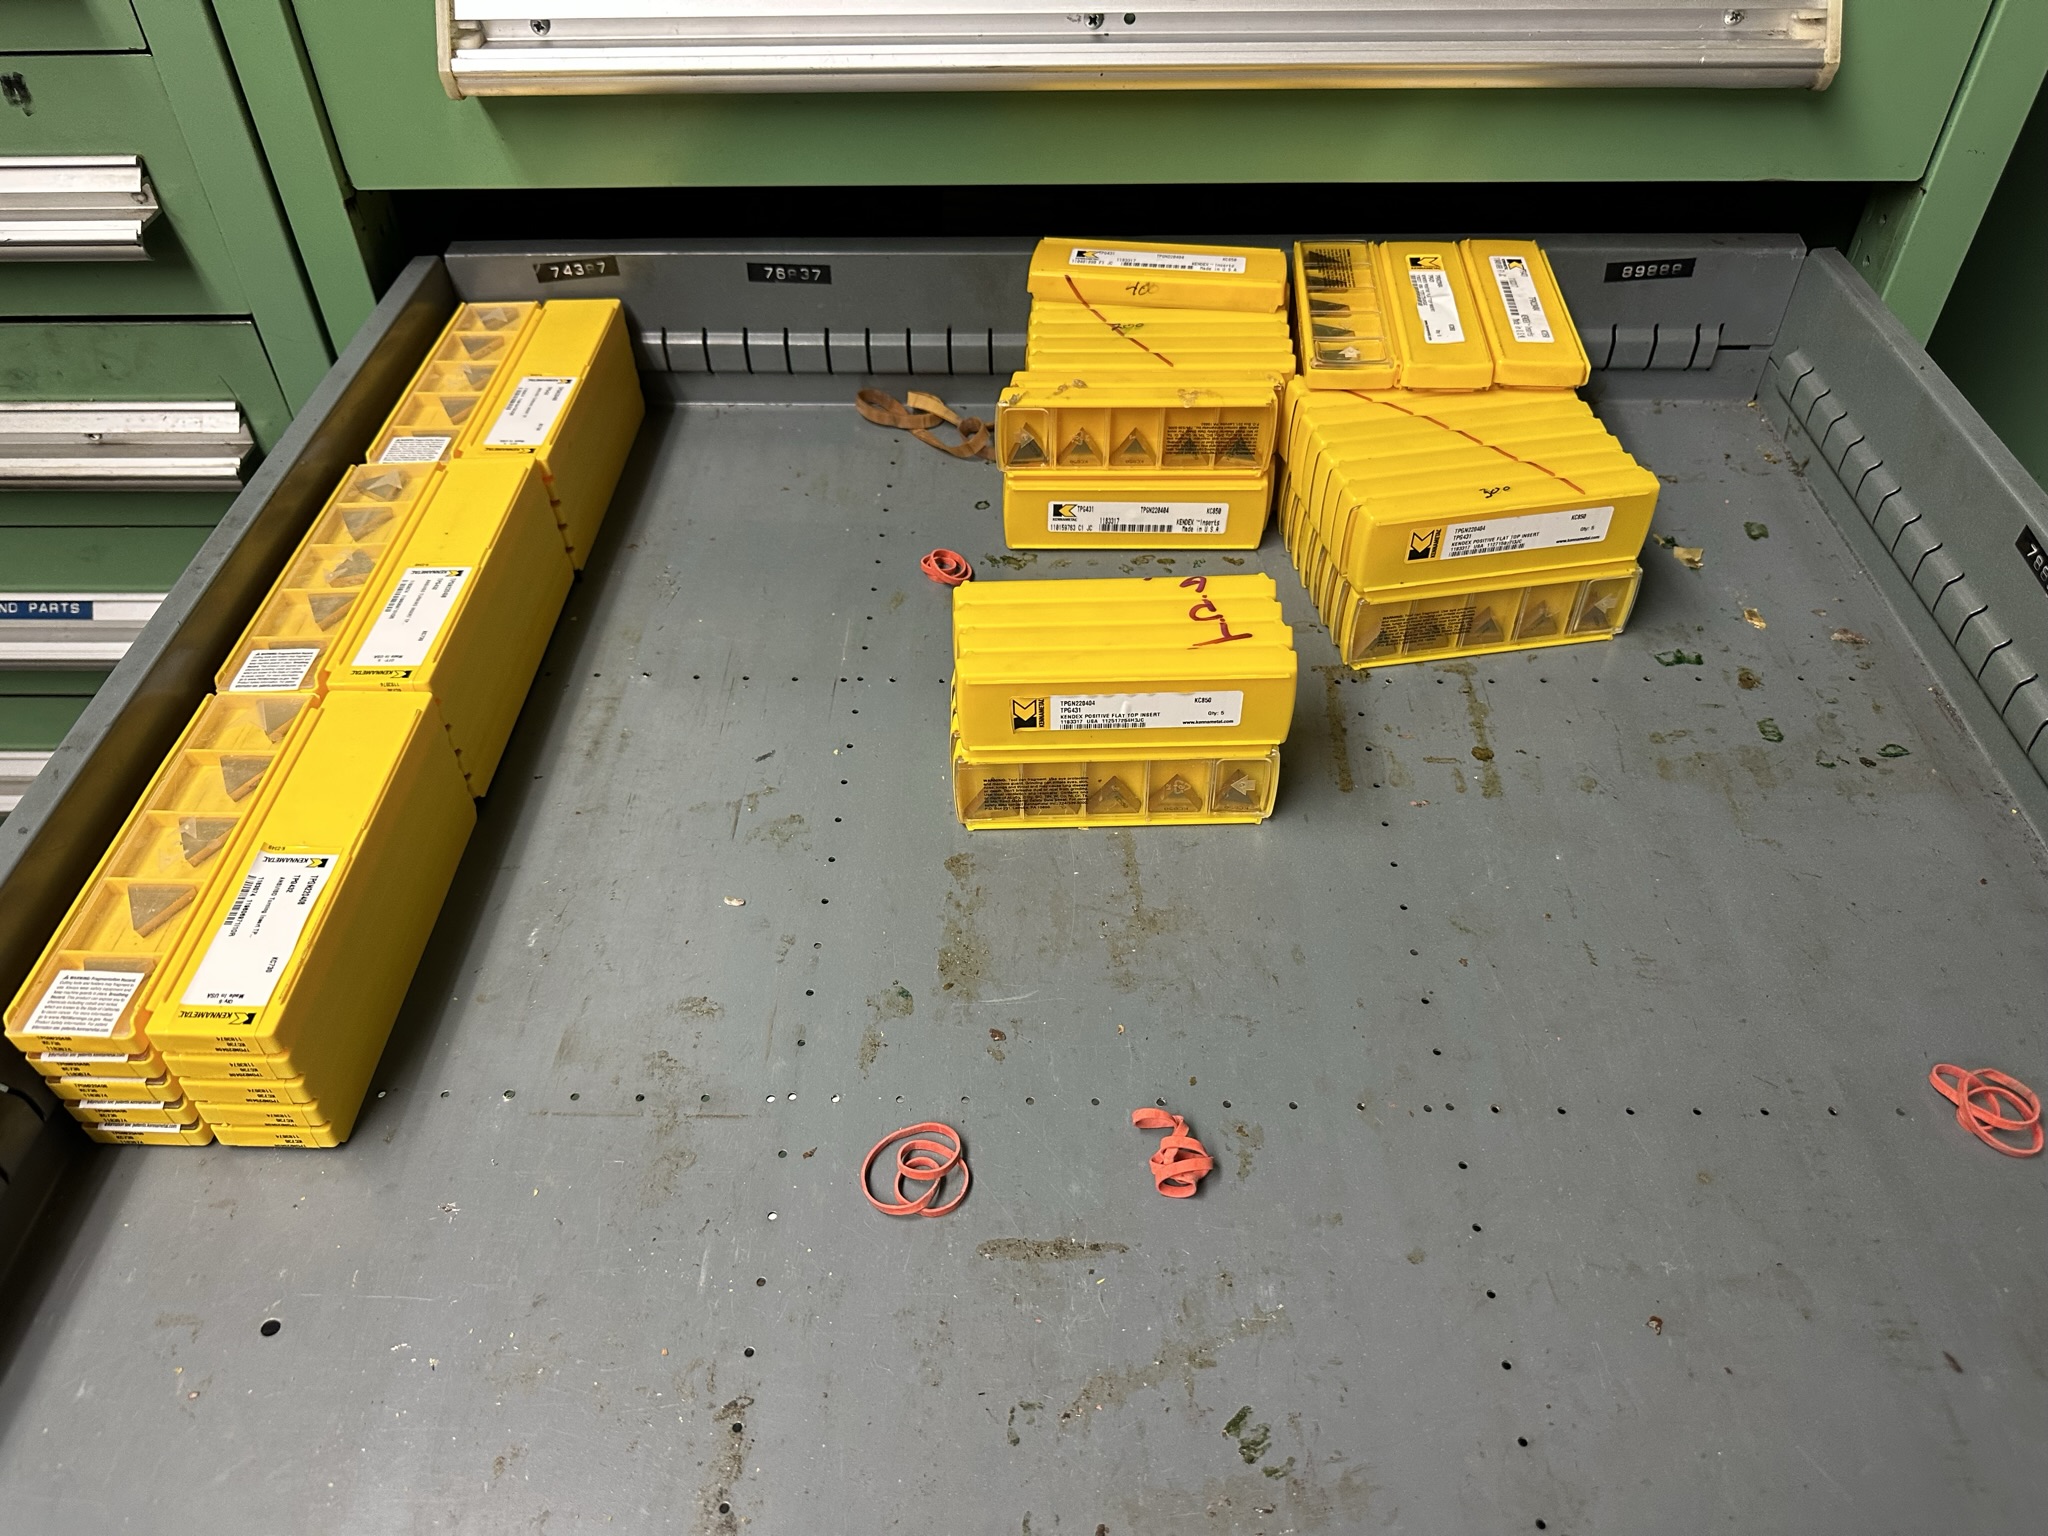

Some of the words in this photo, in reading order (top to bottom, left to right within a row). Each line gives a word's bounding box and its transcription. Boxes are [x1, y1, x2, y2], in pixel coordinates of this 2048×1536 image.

[1430, 528, 1442, 558] KENNAMETAL
[28, 602, 80, 614] PARTS
[261, 898, 275, 914] Turning
[266, 957, 278, 973] KC730
[178, 1010, 233, 1019] KENNAMETAL
